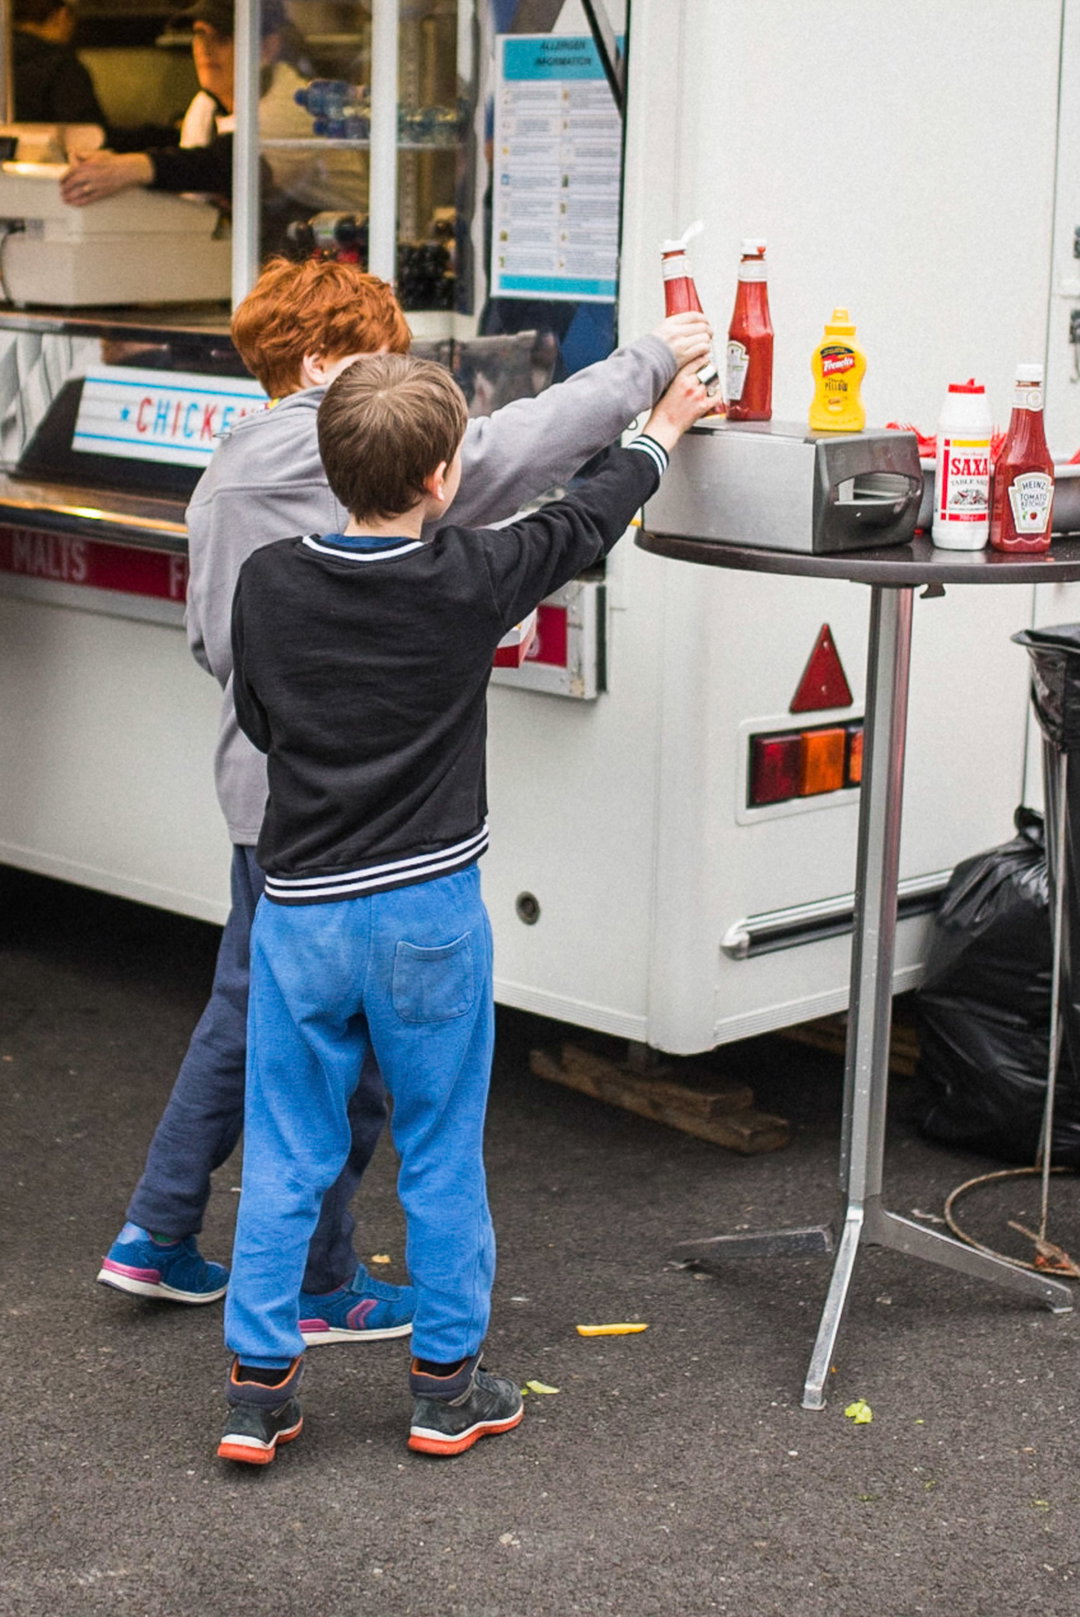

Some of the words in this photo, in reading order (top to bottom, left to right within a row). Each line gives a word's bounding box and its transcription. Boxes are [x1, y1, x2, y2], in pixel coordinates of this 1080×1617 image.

[137, 397, 247, 441] CHICKE
[1022, 480, 1046, 490] HEINZ
[1020, 493, 1048, 502] TOMATO
